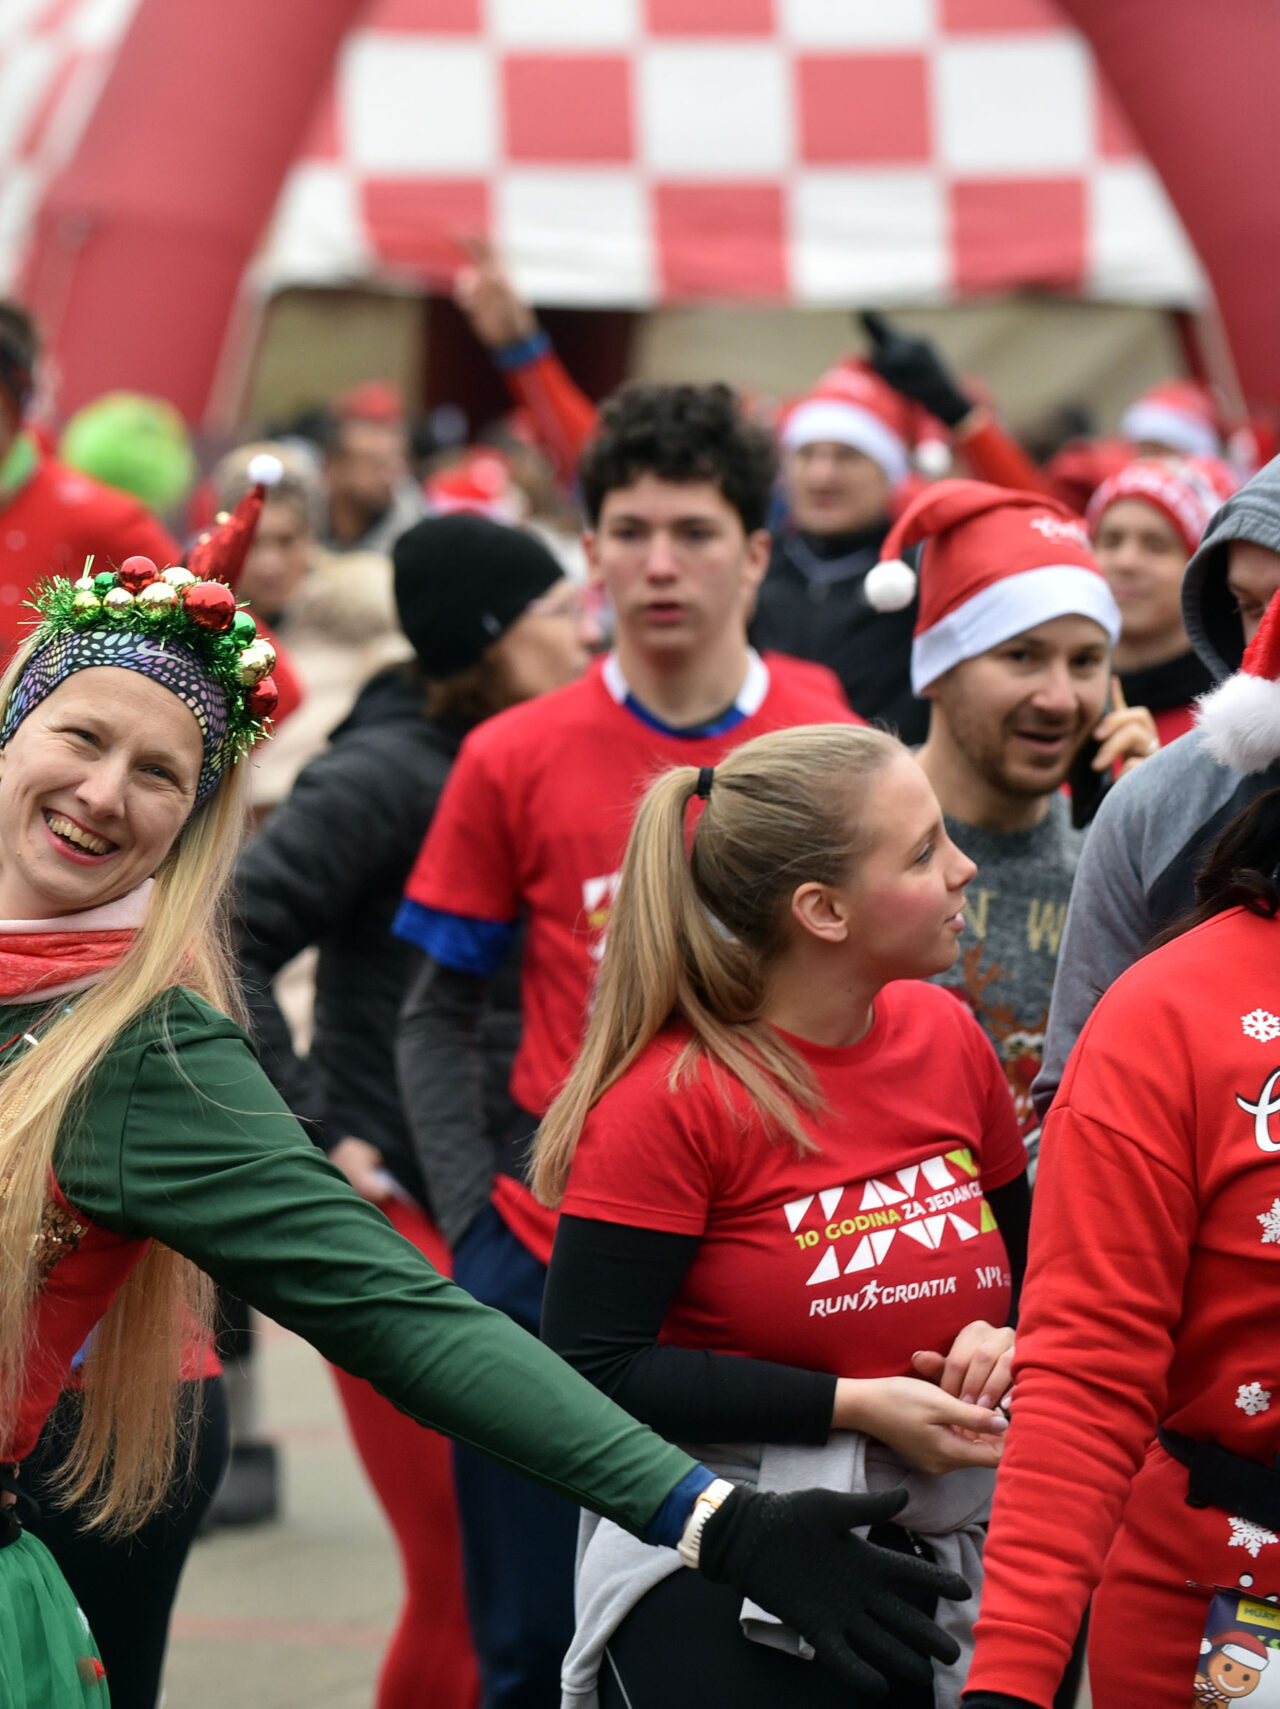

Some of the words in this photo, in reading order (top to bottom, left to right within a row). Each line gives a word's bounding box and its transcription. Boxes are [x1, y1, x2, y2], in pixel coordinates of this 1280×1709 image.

[795, 1230, 820, 1250] 10
[825, 1208, 902, 1240] GODINA
[900, 1200, 927, 1220] ZA
[809, 1292, 859, 1318] RUN
[881, 1276, 958, 1305] CROATIA
